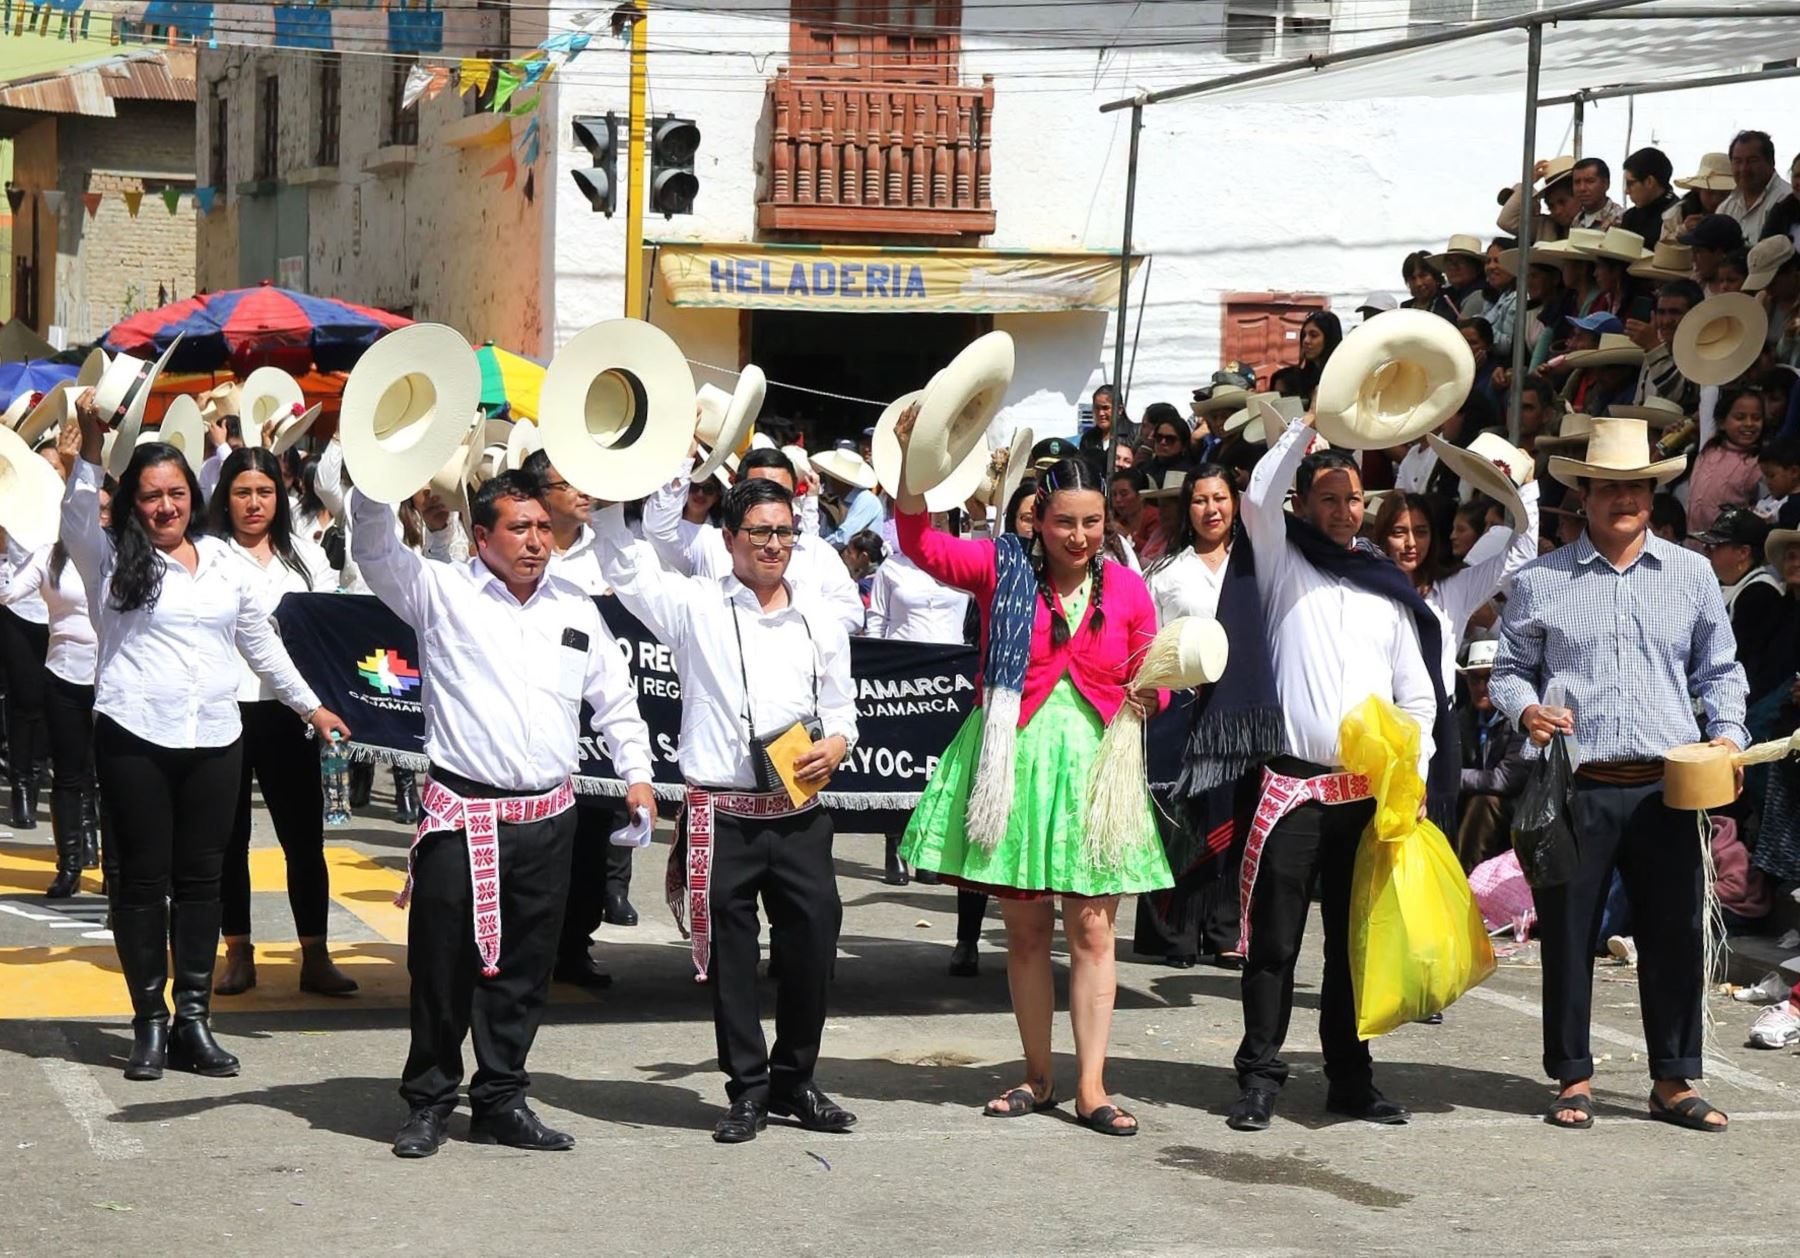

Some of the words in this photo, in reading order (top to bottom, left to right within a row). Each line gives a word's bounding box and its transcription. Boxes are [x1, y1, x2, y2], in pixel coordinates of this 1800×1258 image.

[710, 259, 926, 298] HELADERIA
[850, 674, 975, 700] AMARCA
[348, 690, 424, 713] CAJAMAR
